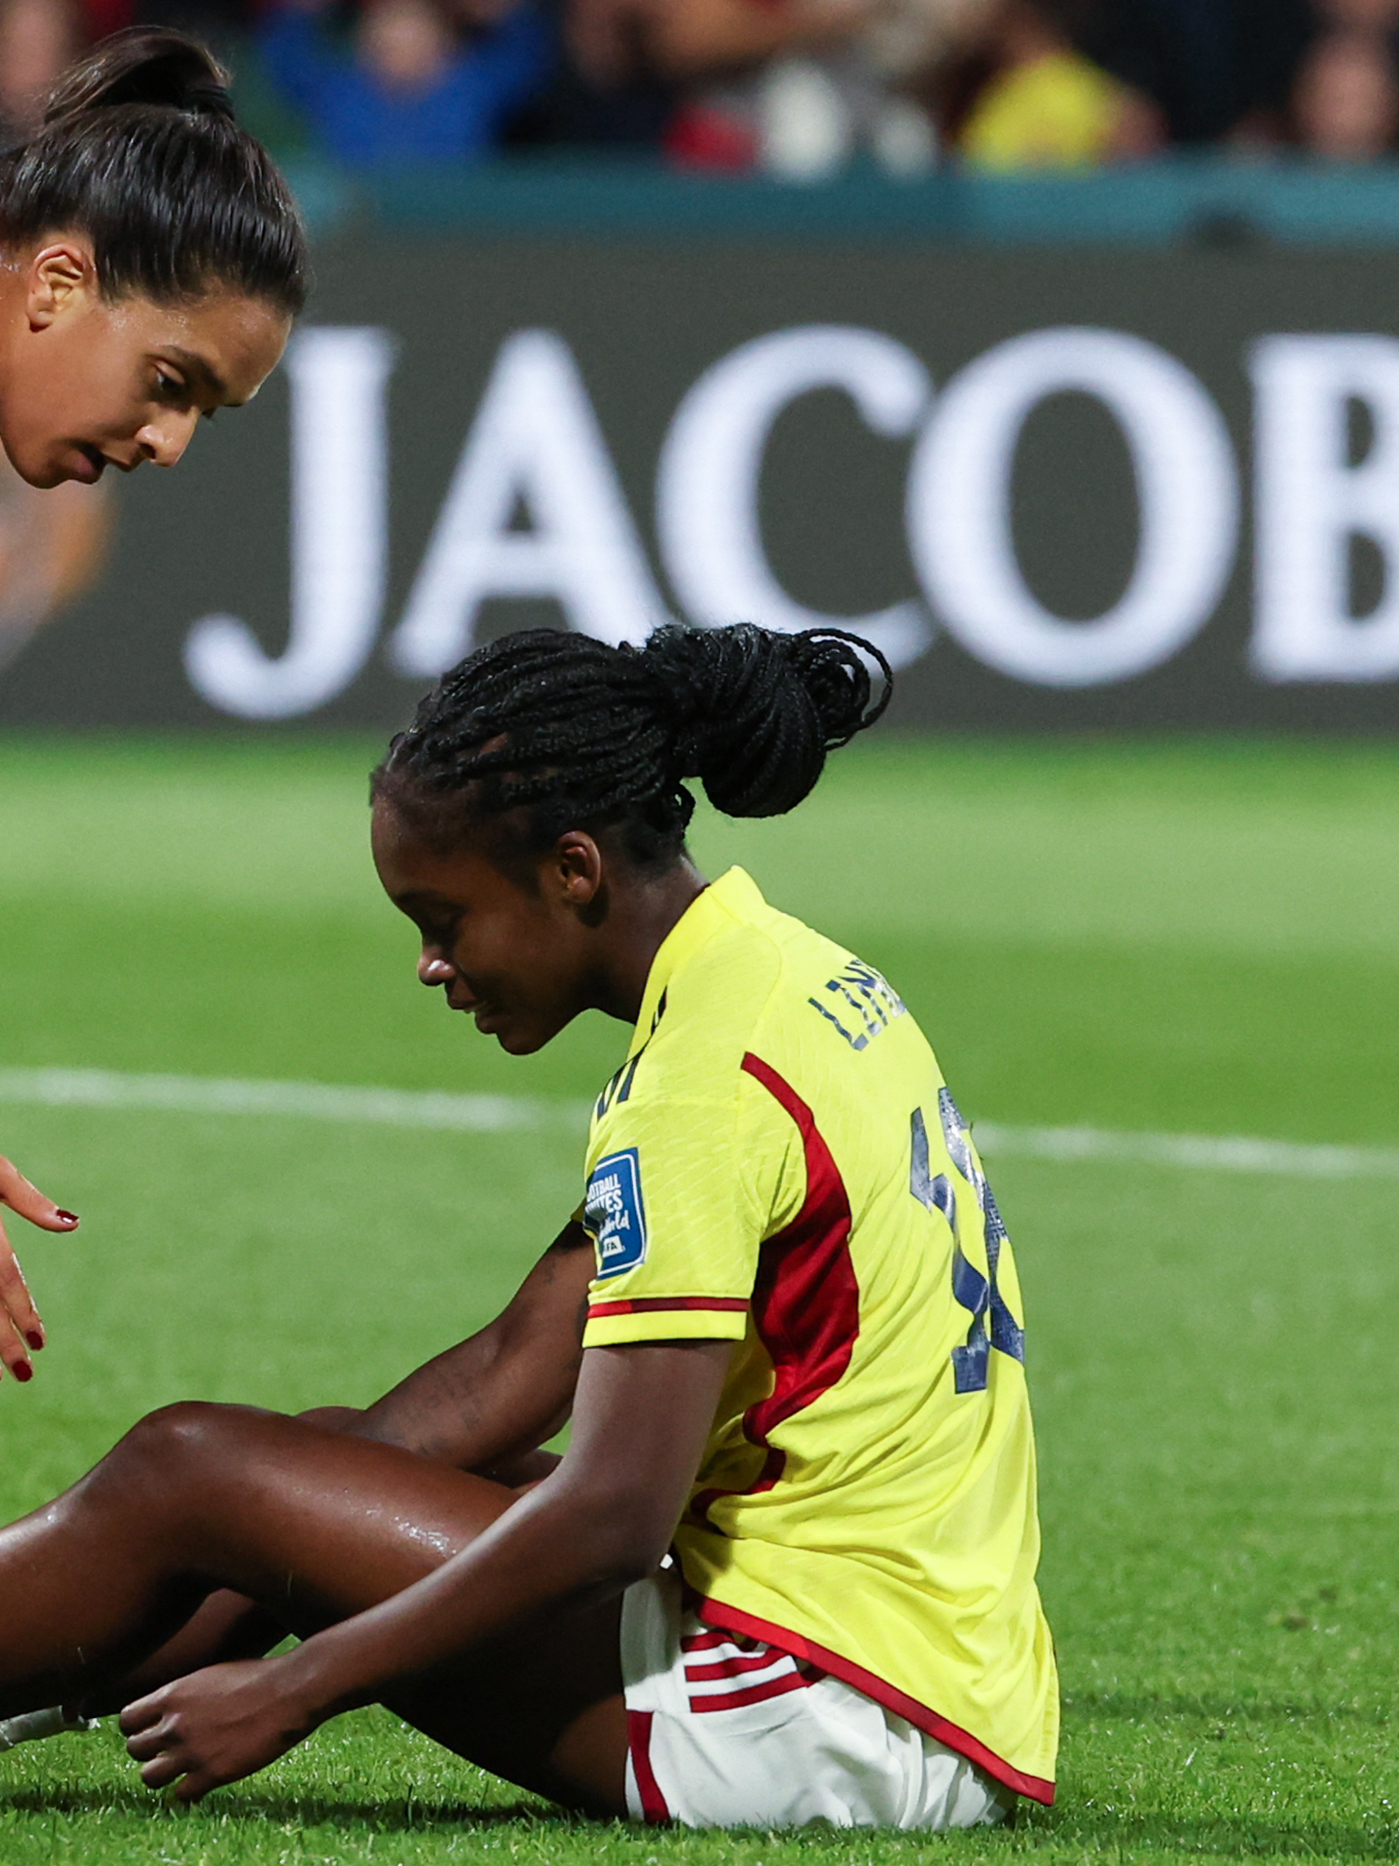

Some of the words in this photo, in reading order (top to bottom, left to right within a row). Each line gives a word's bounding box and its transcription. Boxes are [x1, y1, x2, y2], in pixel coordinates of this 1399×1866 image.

[808, 959, 907, 1051] LIN
[585, 1189, 624, 1213] ITES
[587, 1173, 622, 1202] OTBALL
